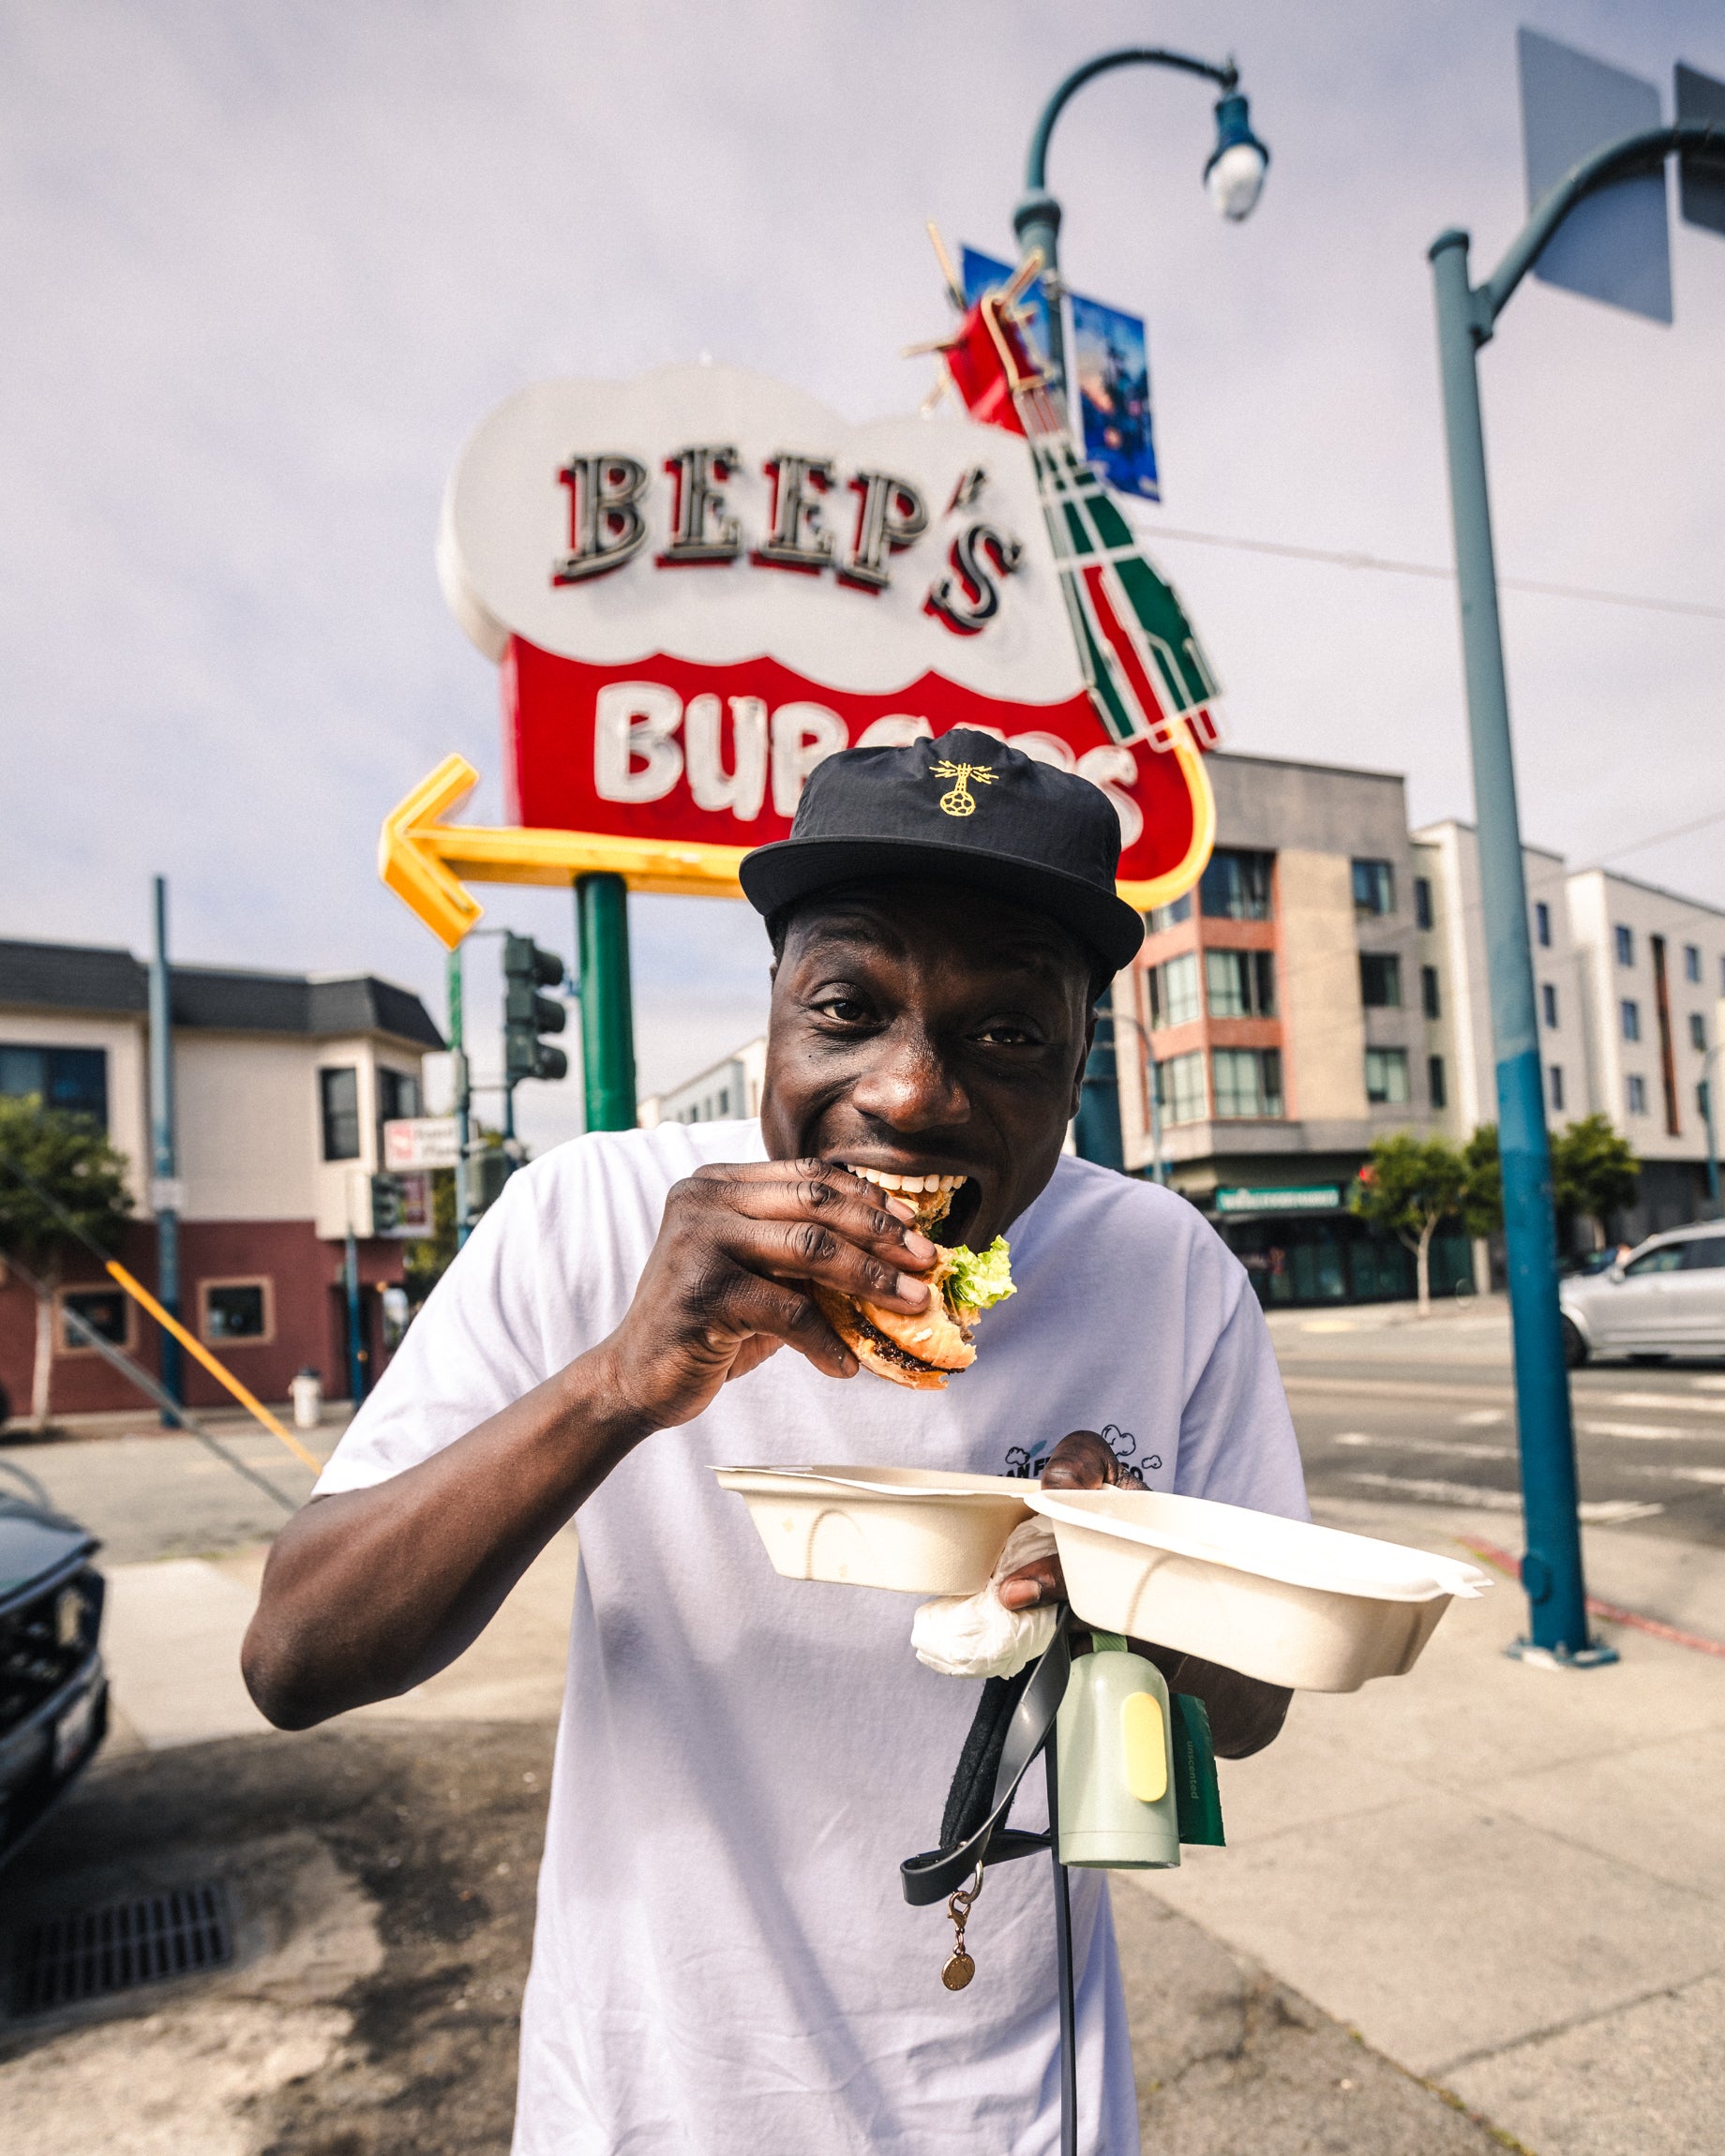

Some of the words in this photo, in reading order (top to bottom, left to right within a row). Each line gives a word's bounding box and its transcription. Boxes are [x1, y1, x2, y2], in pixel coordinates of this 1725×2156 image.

[553, 446, 1026, 636] BEEP'S
[593, 681, 1144, 849] BURS
[1187, 1741, 1199, 1799] unscented
